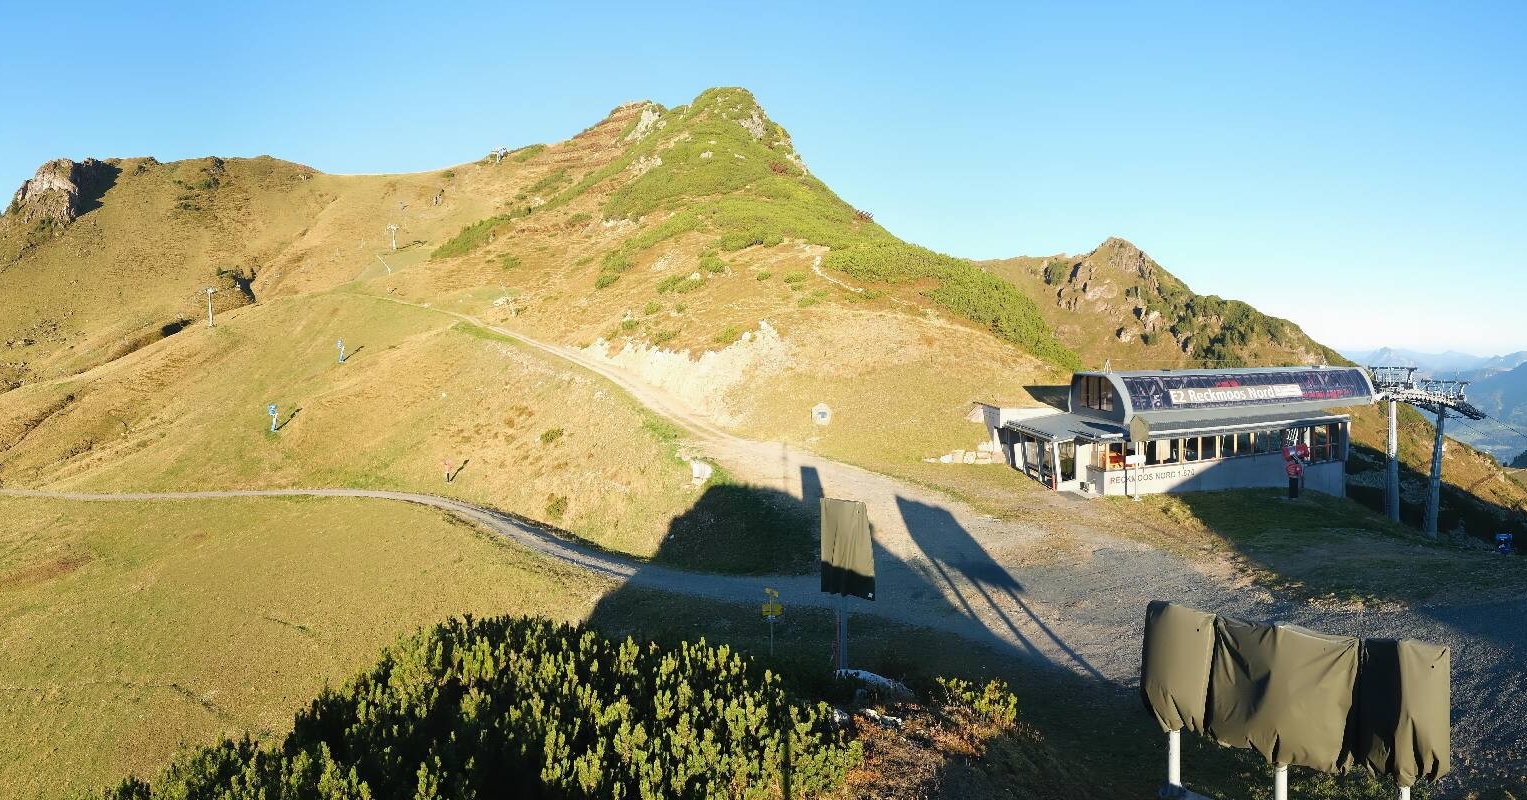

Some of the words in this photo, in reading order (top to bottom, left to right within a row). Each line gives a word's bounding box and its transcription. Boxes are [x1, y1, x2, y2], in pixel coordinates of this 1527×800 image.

[1169, 390, 1186, 403] E2
[1188, 387, 1246, 403] Reckmoos
[1247, 385, 1275, 399] Nord
